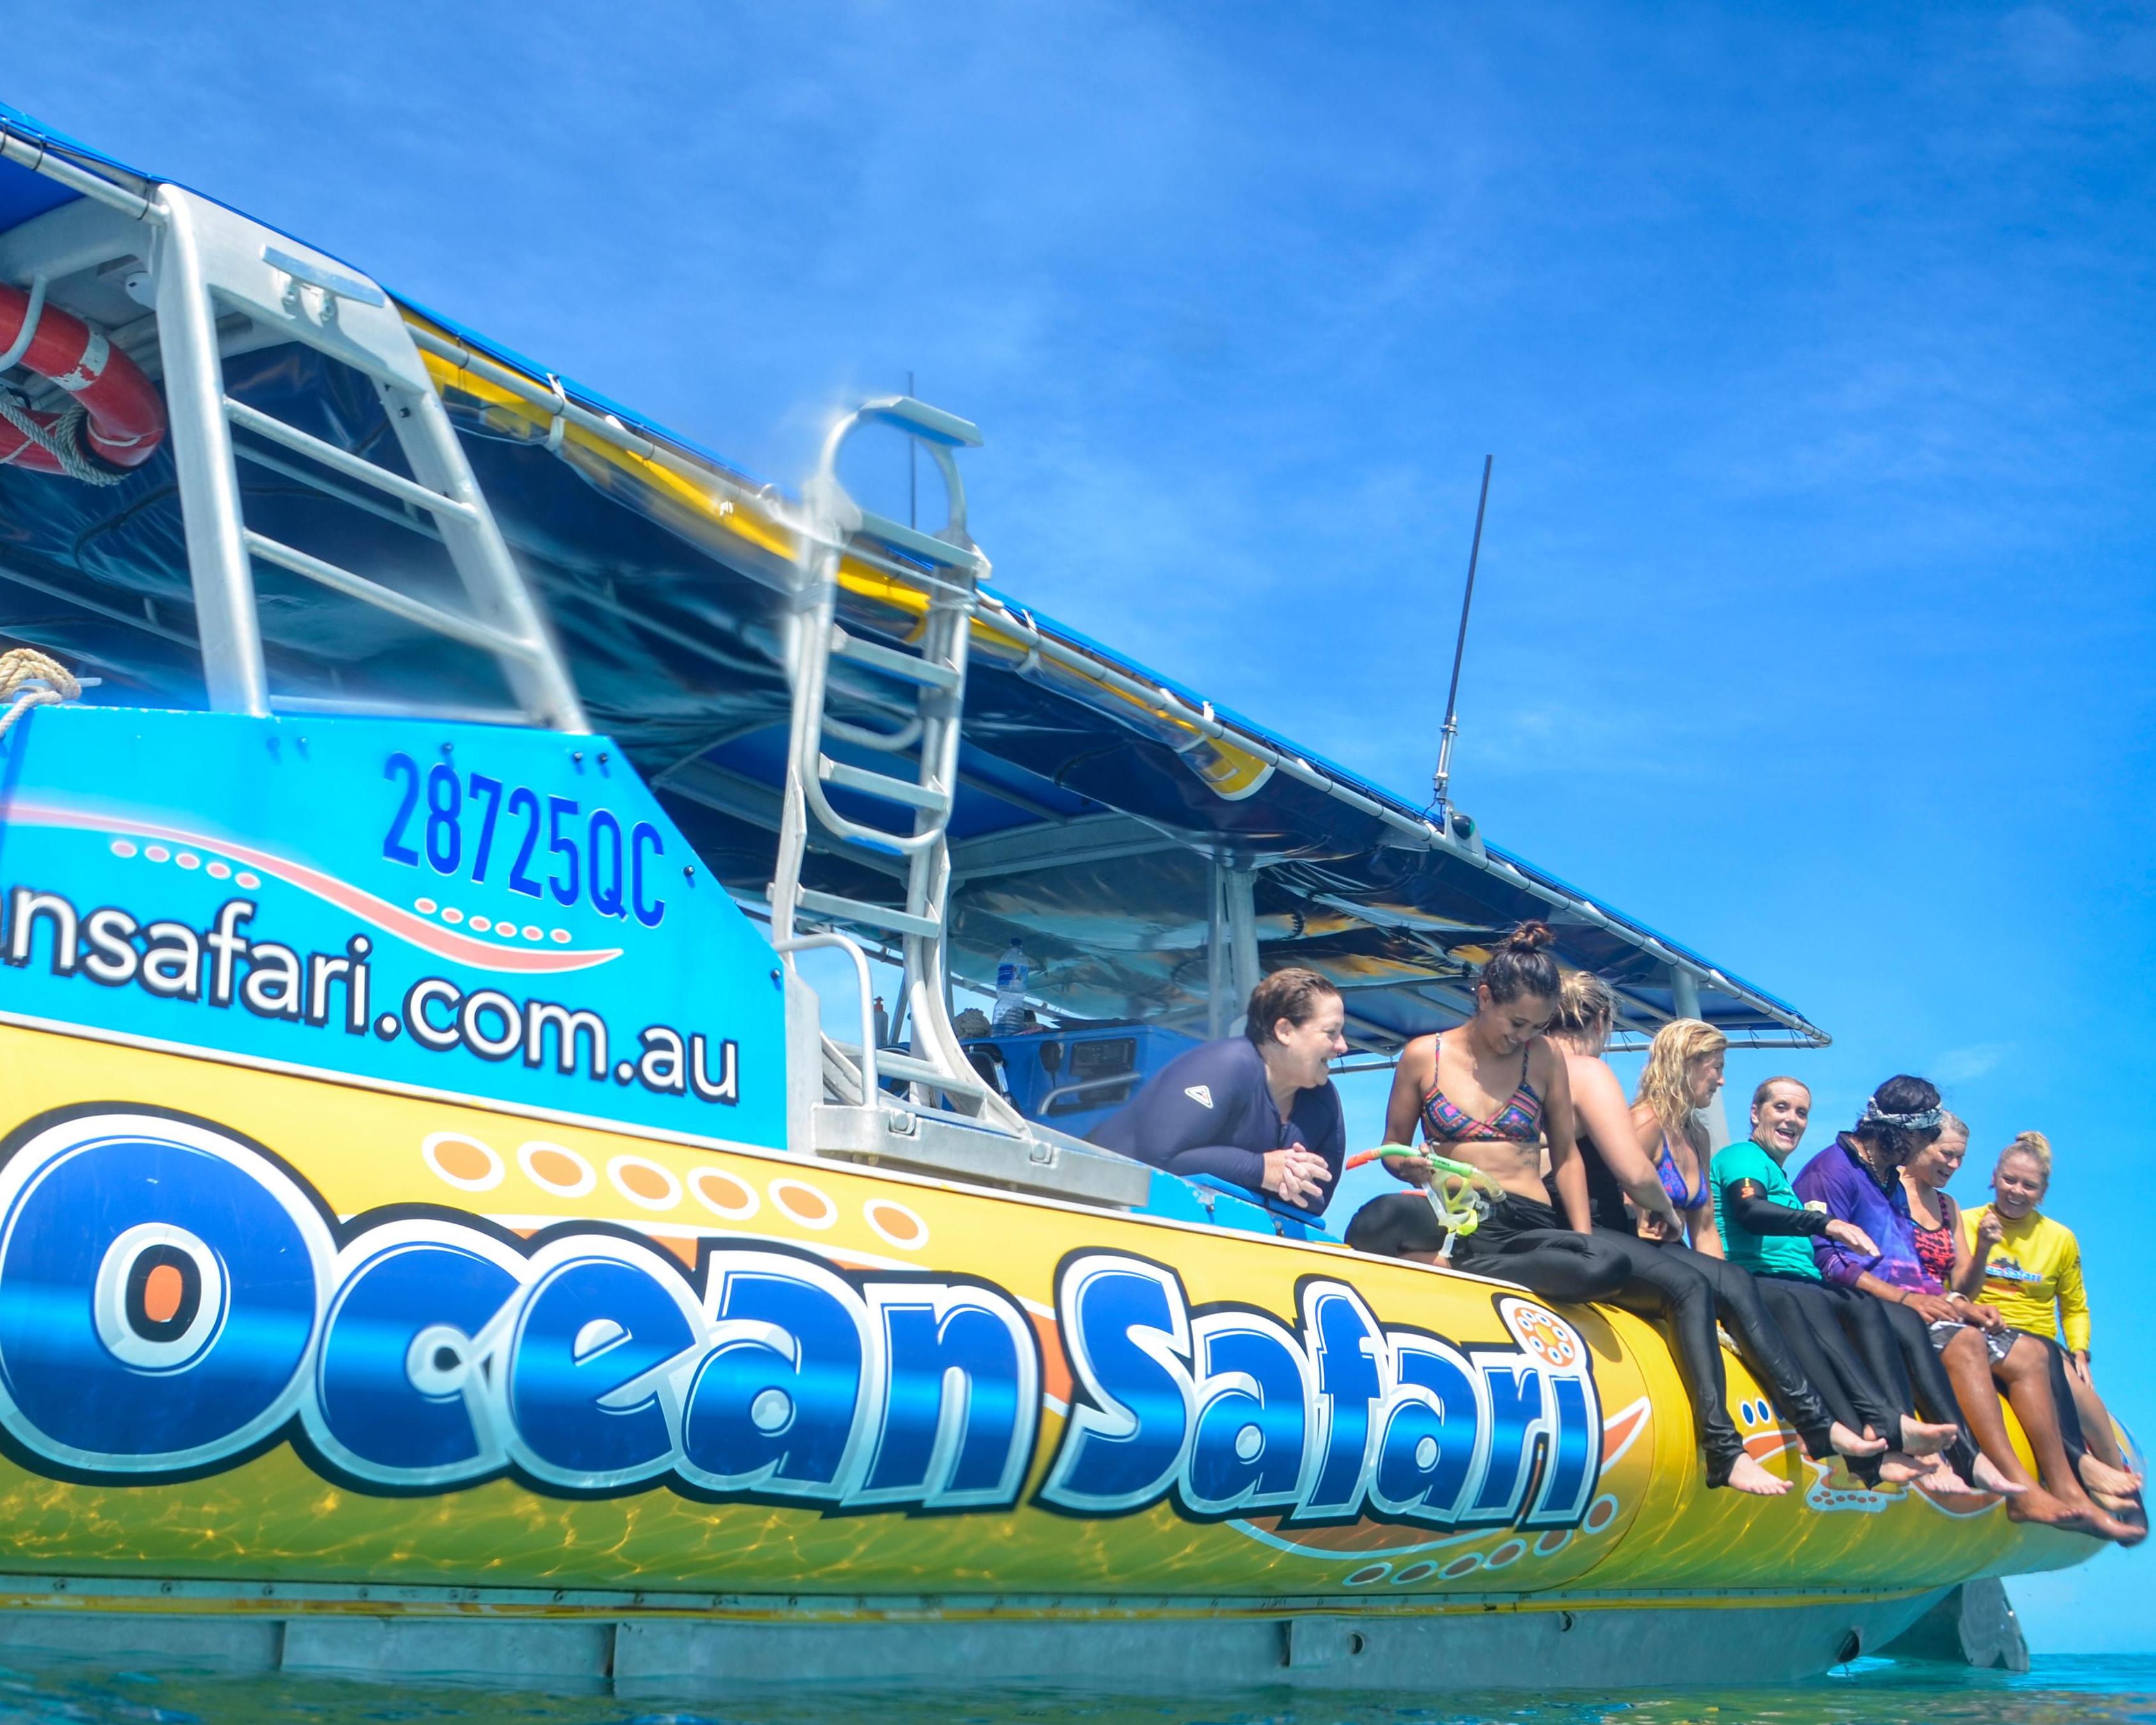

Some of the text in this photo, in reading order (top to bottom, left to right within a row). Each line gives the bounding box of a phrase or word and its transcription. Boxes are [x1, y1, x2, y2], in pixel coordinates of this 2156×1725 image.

[382, 751, 665, 929] 28725QC
[0, 884, 739, 1107] nsafari.com.au
[0, 1103, 1604, 1531] Ocean Safari
